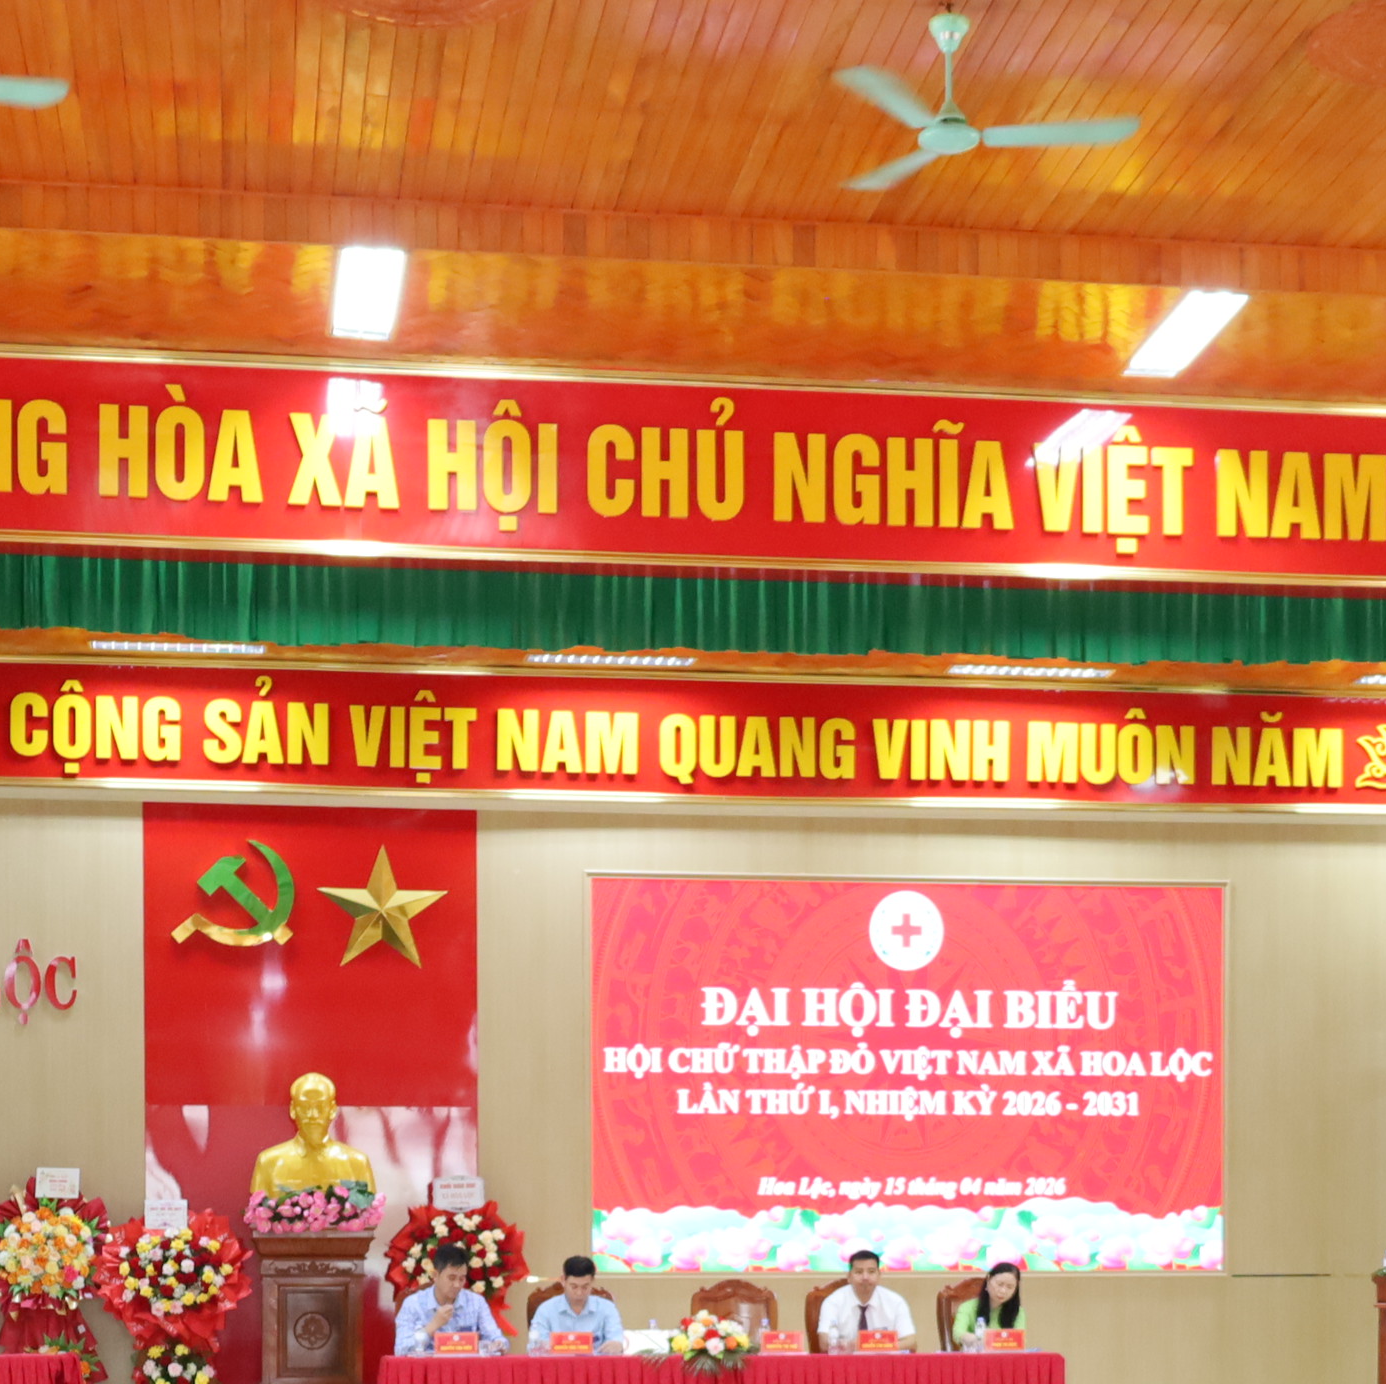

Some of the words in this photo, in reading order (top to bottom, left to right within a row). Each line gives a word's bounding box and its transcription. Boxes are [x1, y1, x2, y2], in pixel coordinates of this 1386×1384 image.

[99, 384, 263, 502] HÒA
[288, 397, 400, 509] XÃ
[427, 399, 558, 531] HỘI
[587, 397, 745, 521] CHỦ
[774, 419, 1014, 530] NGHĨA
[1033, 426, 1194, 555] VIỆT
[10, 680, 181, 774] CỘNG
[203, 676, 329, 765] SẢN
[349, 690, 478, 784] VIỆT
[497, 708, 639, 775] NAM
[659, 713, 856, 785] QUANG
[872, 718, 1010, 782] VINH
[1026, 708, 1195, 785] MUÔN
[1213, 711, 1342, 788] NĂM
[701, 987, 790, 1036] ĐẠI
[801, 981, 894, 1037] HỘI
[905, 989, 992, 1038] ĐẠI
[1003, 979, 1118, 1029] BIỂU
[603, 1043, 662, 1078] HỘI
[668, 1042, 740, 1073] CHỮ
[742, 1044, 826, 1079] THẬP
[829, 1042, 875, 1074] ĐỎ
[879, 1046, 952, 1080] VIỆT
[956, 1050, 1026, 1075] NAM
[1032, 1045, 1075, 1075] XÃ
[1080, 1051, 1146, 1076] HOA
[1150, 1048, 1212, 1082] LỘC
[677, 1082, 740, 1114] LẦN
[745, 1082, 814, 1114] THỨ
[818, 1089, 839, 1118] I,
[844, 1086, 946, 1121] NHIỆM
[952, 1083, 997, 1115] KỲ
[1002, 1091, 1061, 1115] 2026
[1083, 1091, 1138, 1116] 2031
